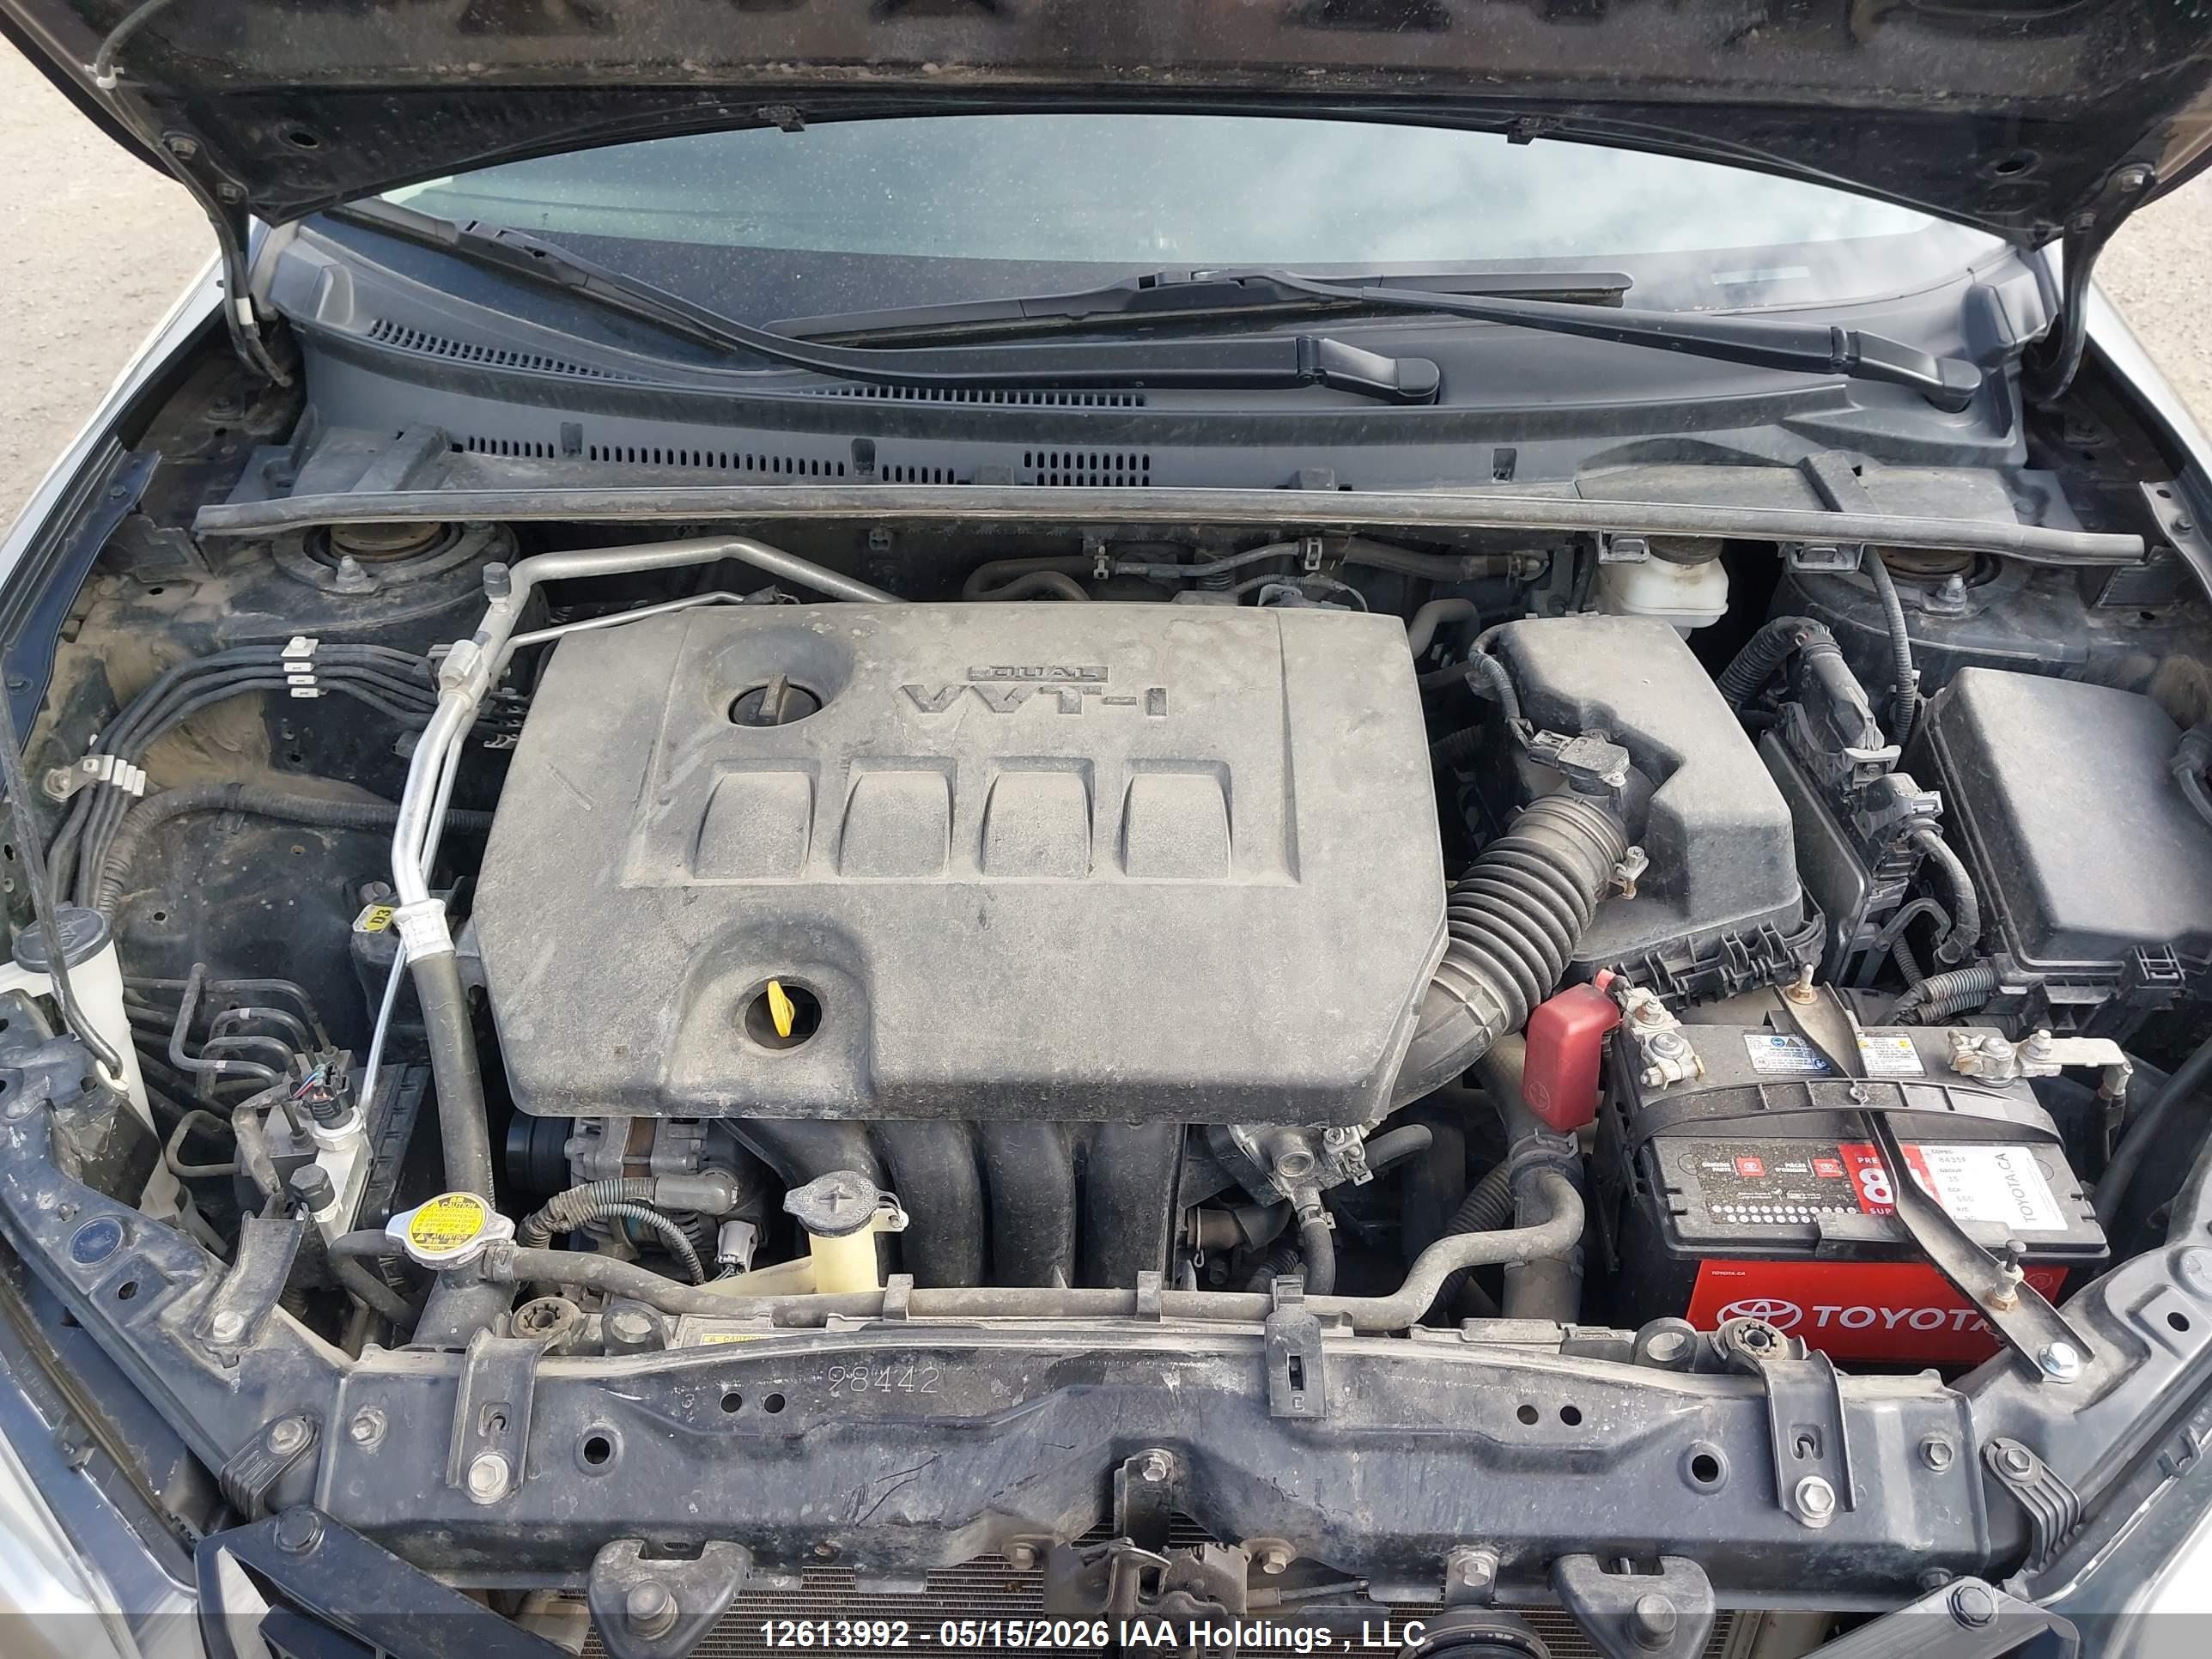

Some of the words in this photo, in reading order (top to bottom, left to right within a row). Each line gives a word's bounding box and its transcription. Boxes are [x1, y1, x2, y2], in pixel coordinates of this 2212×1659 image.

[988, 665, 1099, 679] DUAL
[369, 908, 392, 925] D3
[1994, 1152, 2038, 1224] TOYOTA.CA
[828, 1364, 940, 1393] 98442
